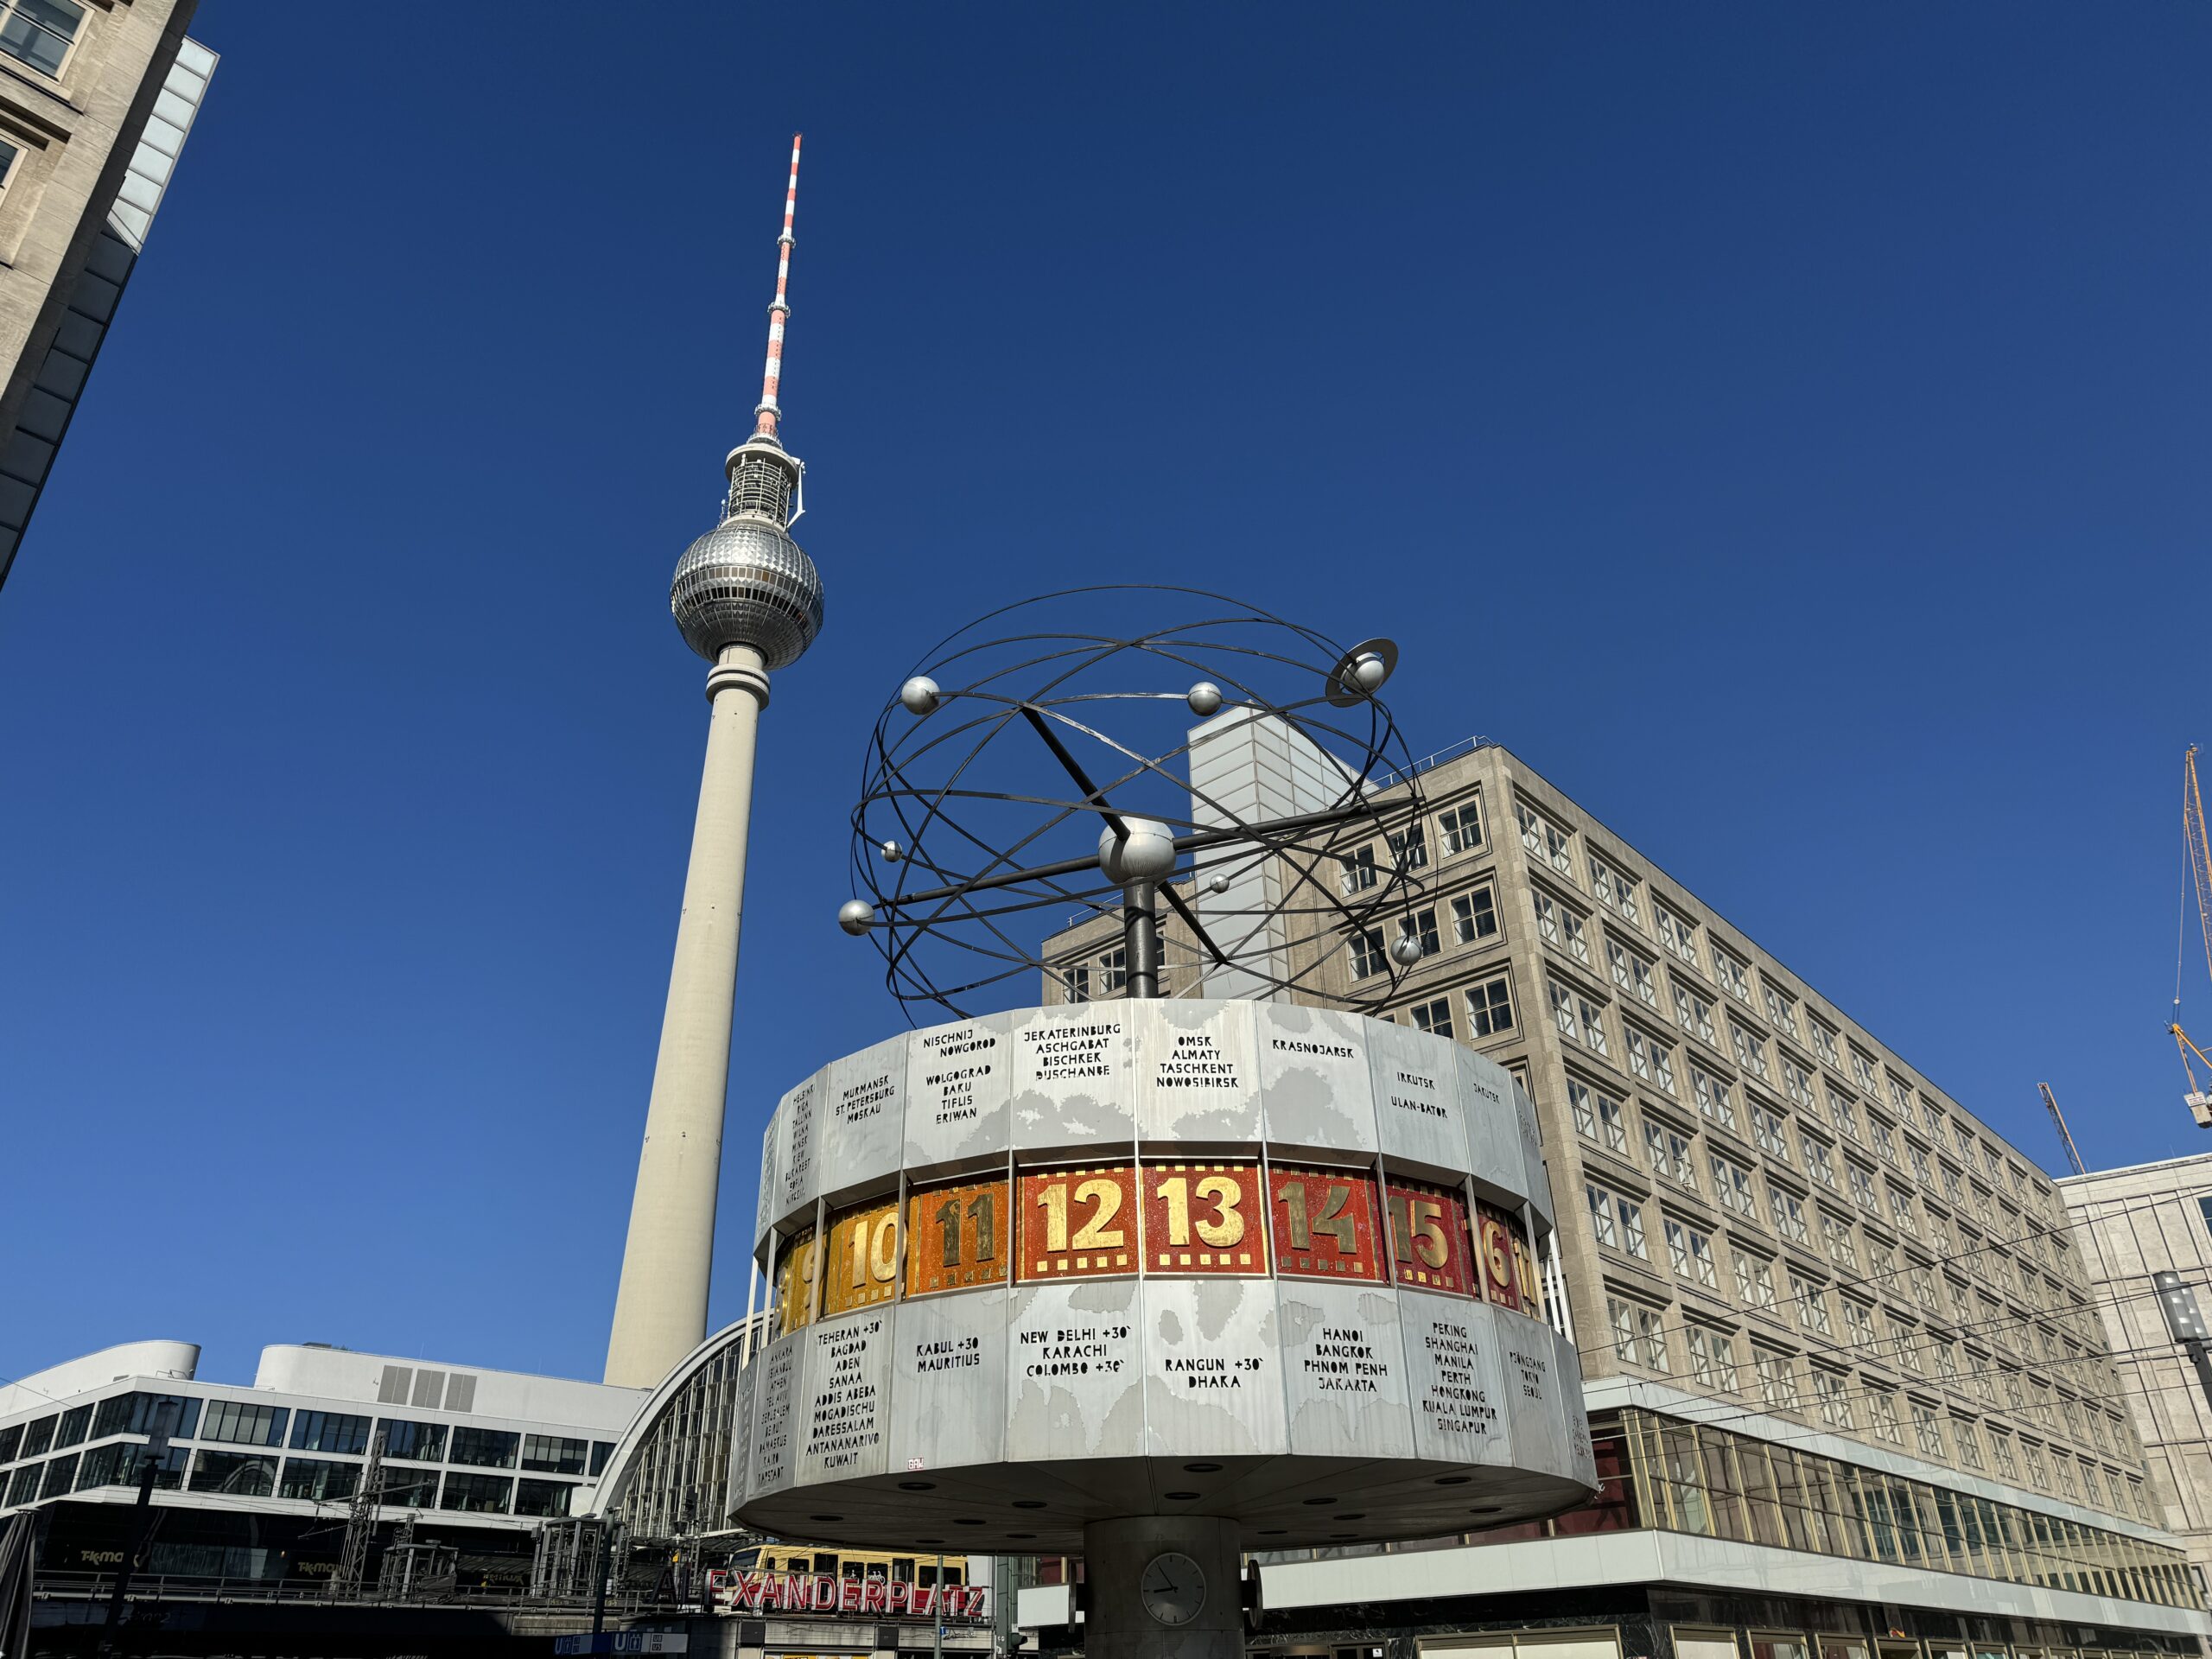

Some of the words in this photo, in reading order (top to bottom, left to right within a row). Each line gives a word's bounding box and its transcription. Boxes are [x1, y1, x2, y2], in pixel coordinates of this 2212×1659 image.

[924, 1029, 973, 1048] NISCHNIJ
[1024, 1023, 1121, 1042] JEKATERINBURG
[1178, 1036, 1212, 1047] OMSK
[940, 1038, 996, 1058] NOWGOROD
[1035, 1038, 1109, 1054] ASCHGABAT
[1172, 1049, 1221, 1060] ALMATY
[1273, 1039, 1354, 1058] KRASNOJARSK
[1043, 1052, 1102, 1067] BISCHKEK
[1160, 1063, 1234, 1074] TASCHKENT
[926, 1065, 991, 1086] WOLGOGRAD
[1036, 1065, 1110, 1081] DUSCHANBE
[1397, 1071, 1435, 1090] IRKUTSK
[842, 1075, 889, 1101] MURMANSK
[1157, 1077, 1239, 1088] NOWOSIBIRSK
[836, 1104, 845, 1116] ST.
[847, 1086, 894, 1112] PETERSBURG
[1473, 1083, 1500, 1104] JAKUTSK
[797, 1100, 808, 1114] RIGA
[942, 1096, 973, 1110] TIFLIS
[1391, 1096, 1448, 1119] ULAN-BATOR
[792, 1109, 812, 1129] TALLINN
[847, 1103, 880, 1124] MOSKAU
[936, 1107, 977, 1124] ERIWAN
[793, 1124, 808, 1141] WILNA
[791, 1135, 808, 1153] MINSK
[792, 1151, 804, 1164] KIEW
[1037, 1179, 1124, 1253] 12
[1157, 1176, 1245, 1248] 13
[1278, 1181, 1357, 1255] 14
[936, 1193, 995, 1268] 11
[1388, 1195, 1449, 1268] 15
[848, 1211, 907, 1288] 10
[818, 1325, 860, 1346] TEHERAN
[1020, 1331, 1049, 1344] NEW
[1057, 1328, 1096, 1342] DELHI
[1322, 1327, 1363, 1342] HANOI
[1433, 1322, 1467, 1338] PEKING
[770, 1344, 793, 1364] ANKARA
[831, 1340, 867, 1358] BAGDAD
[916, 1340, 954, 1357] KABUL
[1042, 1344, 1108, 1359] KARACHI
[1315, 1344, 1373, 1359] BANGKOK
[1426, 1336, 1478, 1356] SHANGHAI
[835, 1357, 861, 1372] ADEN
[918, 1353, 980, 1372] MAURITIUS
[1027, 1362, 1088, 1377] COLOMBO
[1166, 1358, 1224, 1371] RANGUN
[1304, 1360, 1349, 1374] PHNOM
[1355, 1363, 1388, 1376] PENH
[1434, 1353, 1474, 1370] MANILA
[1510, 1351, 1546, 1372] PJÖNGJANG
[769, 1376, 787, 1394] ATHEN
[829, 1372, 862, 1389] SANAA
[1188, 1375, 1241, 1389] DHAKA
[1319, 1376, 1377, 1393] JAKARTA
[1441, 1370, 1471, 1385] PERTH
[1521, 1370, 1539, 1385] TOKYO
[776, 1389, 788, 1402] AVIV
[815, 1391, 842, 1408] ADDIS
[846, 1384, 875, 1402] ABEBA
[1431, 1384, 1485, 1403] HONGKONG
[1523, 1384, 1542, 1400] SEOUL
[761, 1403, 791, 1424] JERUSALEM
[814, 1401, 875, 1424] MOGADISCHU
[1459, 1403, 1497, 1421] LUMPUR
[765, 1421, 783, 1438] BEIRUT
[812, 1417, 874, 1440] DARESSALAM
[1437, 1418, 1487, 1435] SINGAPUR
[759, 1435, 787, 1455] DAMASKUS
[805, 1432, 880, 1457] ANTANANARIVO
[763, 1452, 779, 1468] KAIRO
[823, 1452, 858, 1469] KUWAIT
[758, 1466, 784, 1485] KAPSTADT
[648, 1567, 986, 1617] ALEXANDERPLATZ
[613, 1632, 626, 1650] U
